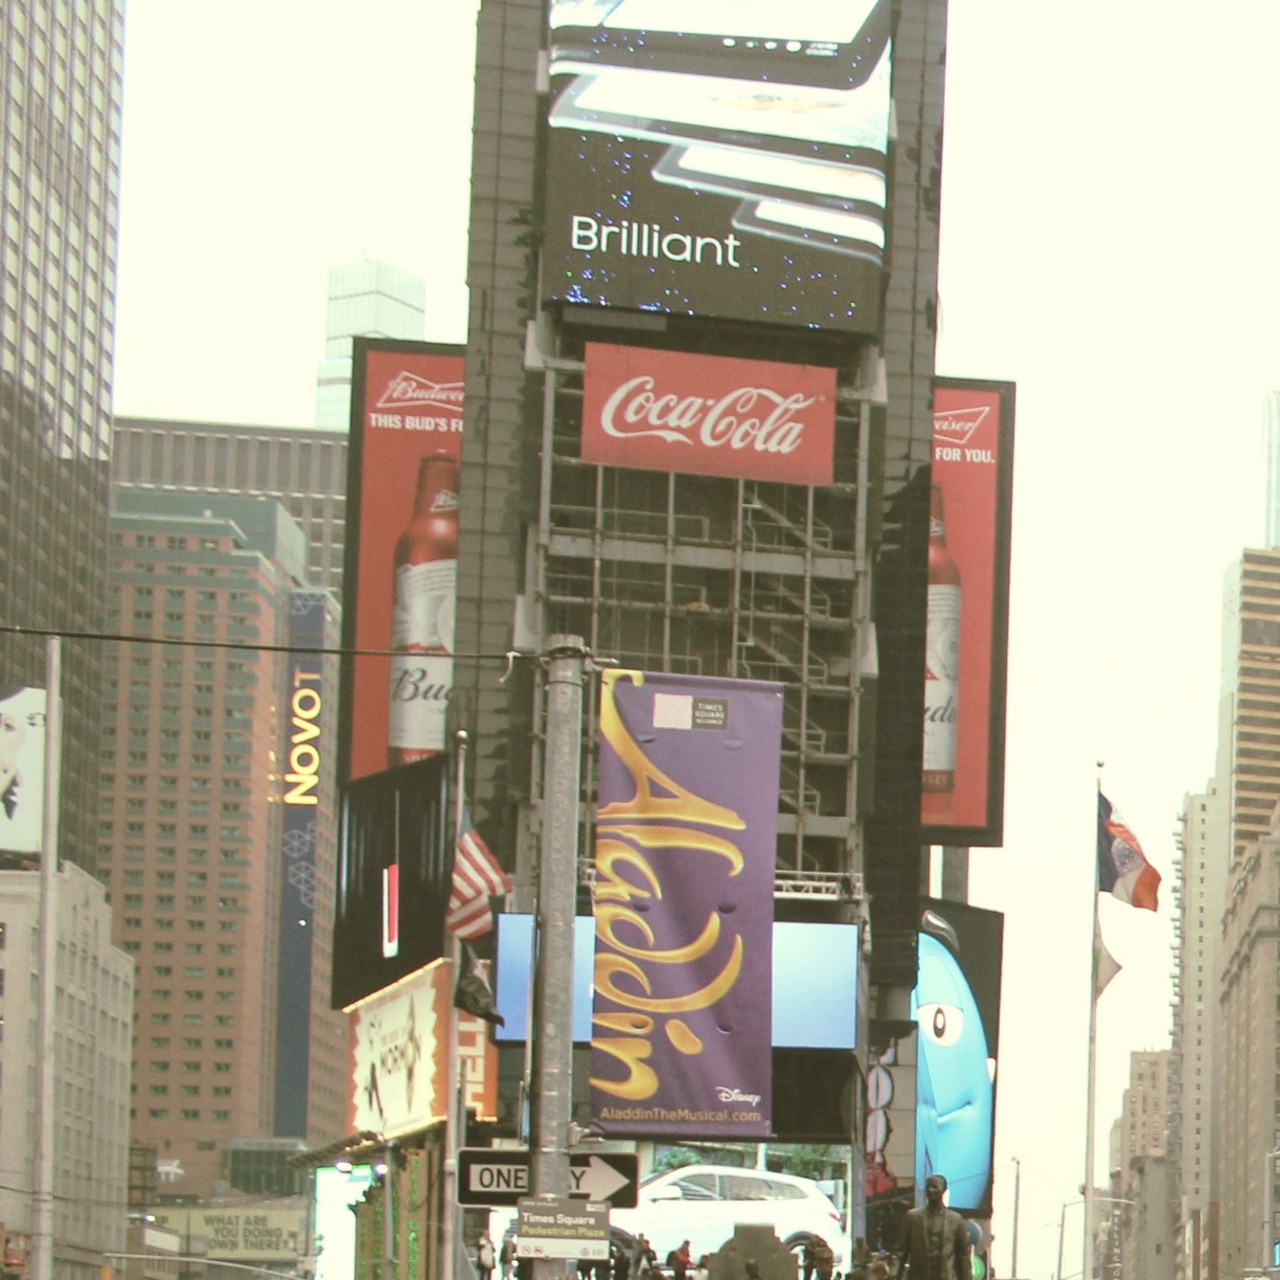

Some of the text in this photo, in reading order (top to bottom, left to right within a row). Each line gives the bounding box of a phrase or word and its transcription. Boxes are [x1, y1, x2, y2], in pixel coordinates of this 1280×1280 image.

[570, 214, 741, 268] Brilliant
[369, 412, 448, 432] THIS BUD'S
[935, 447, 996, 464] FOR YOU.
[716, 1086, 761, 1107] Disney
[600, 1106, 761, 1123] AladdinTheMusical.com
[479, 1166, 528, 1190] ONE
[203, 1215, 268, 1226] WHAT ARE
[522, 1211, 596, 1226] Times Square
[213, 1227, 283, 1238] YOU DOING
[521, 1225, 606, 1237] Pedestrian Plaza
[207, 1239, 238, 1250] OWN
